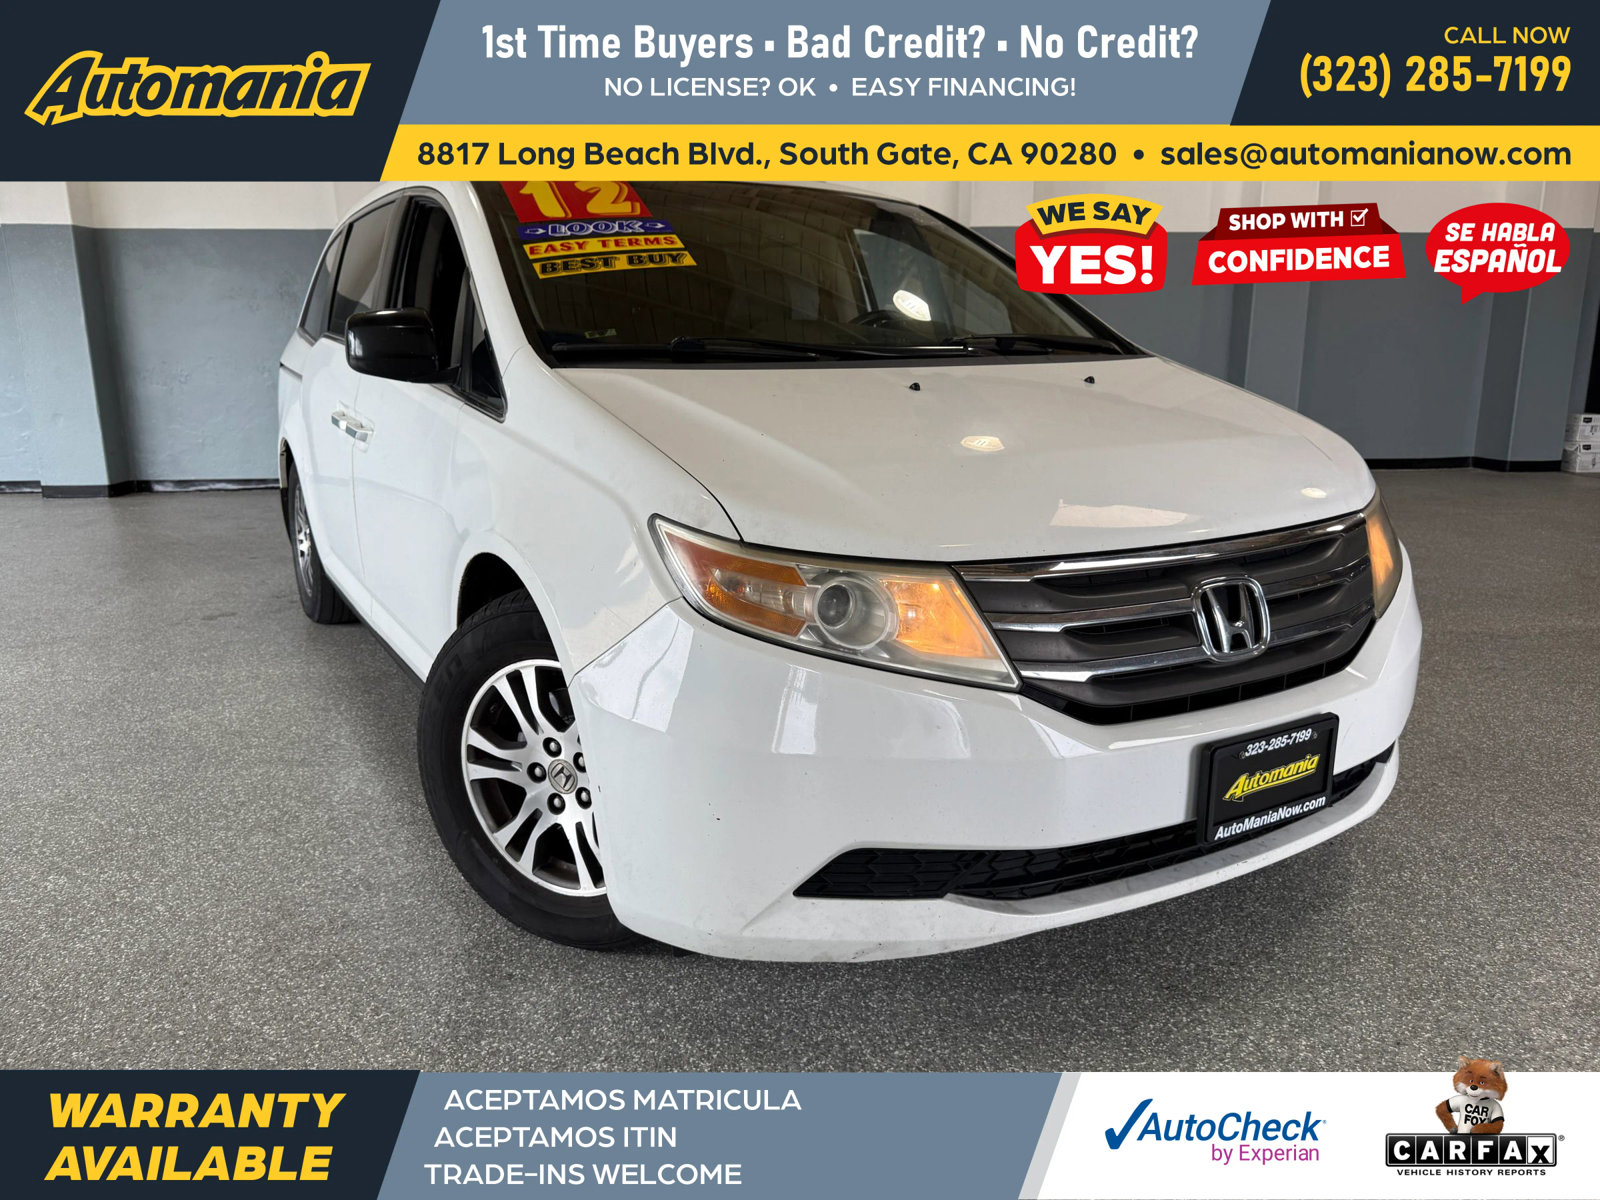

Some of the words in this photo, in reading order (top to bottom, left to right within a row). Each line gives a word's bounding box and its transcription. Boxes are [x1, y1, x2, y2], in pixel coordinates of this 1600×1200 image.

[548, 220, 645, 237] LOOK
[529, 240, 589, 256] EASY
[597, 236, 678, 249] TERMS
[540, 256, 619, 276] BEST
[627, 252, 688, 267] BUY
[1245, 728, 1312, 757] 323-285-7199
[1222, 753, 1320, 802] Automania
[1214, 796, 1326, 840] AutoManiaNow.com
